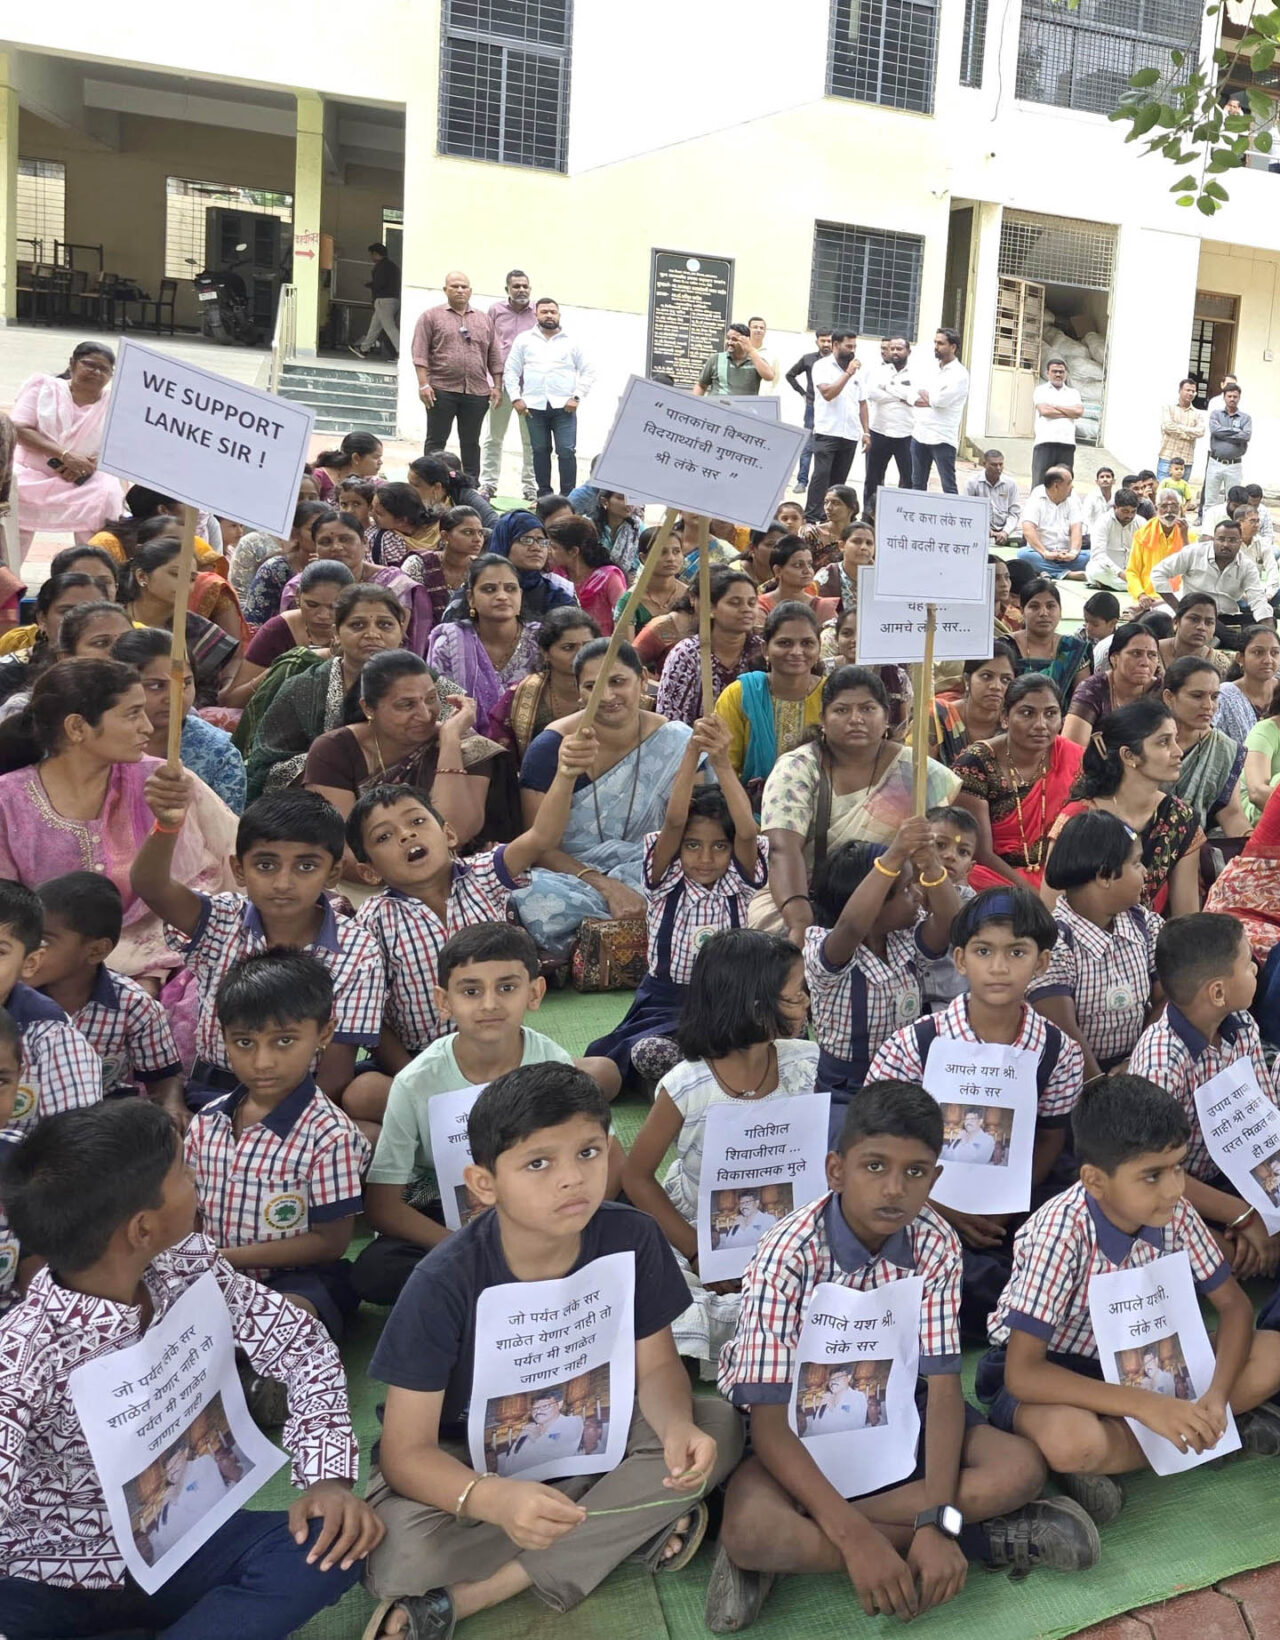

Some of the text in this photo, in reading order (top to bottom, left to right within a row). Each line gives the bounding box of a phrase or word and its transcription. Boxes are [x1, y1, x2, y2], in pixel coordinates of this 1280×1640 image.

[143, 371, 284, 440] WE SUPPORT
[666, 408, 721, 434] पालकांचा
[145, 407, 266, 468] LANKE SIR !
[655, 451, 670, 467] श्री
[674, 458, 698, 473] लंके
[702, 468, 720, 481] सर
[919, 514, 936, 525] करा
[940, 512, 956, 526] लंके
[959, 517, 973, 528] सर
[887, 534, 908, 550] यांची
[911, 536, 934, 552] बदली
[938, 542, 949, 553] रद्द
[880, 620, 970, 633] आमचे सर...
[945, 1063, 1017, 1080] आपले यश श्री.
[959, 1082, 1003, 1097] लंके सर
[1207, 1097, 1232, 1117] उपाय
[744, 1122, 791, 1139] गतिशिल
[1210, 1109, 1245, 1137] नाही श्री
[1222, 1118, 1268, 1153] परत मिळत
[725, 1144, 787, 1161] शिवाजीराव
[1252, 1144, 1264, 1158] ही
[717, 1159, 807, 1181] विकासात्मक मुले
[508, 1311, 525, 1325] जो
[562, 1298, 581, 1317] लंके
[583, 1290, 600, 1304] सर
[1108, 1294, 1144, 1315] आपले
[496, 1305, 612, 1351] शाळेत येणार नाही तो
[811, 1309, 895, 1331] आपले यश श्री.
[1129, 1315, 1167, 1337] लंके सर
[547, 1345, 560, 1359] मी
[564, 1333, 597, 1354] शाळेत
[825, 1340, 879, 1354] लंके सर
[112, 1381, 134, 1398] जो
[179, 1324, 197, 1344] सर
[520, 1353, 587, 1384] जाणार नाही
[107, 1336, 214, 1429] शाळेत येणार नाही तो
[165, 1398, 177, 1413] मी
[179, 1368, 207, 1400] शाळेत
[147, 1392, 203, 1451] जाणार नाही
